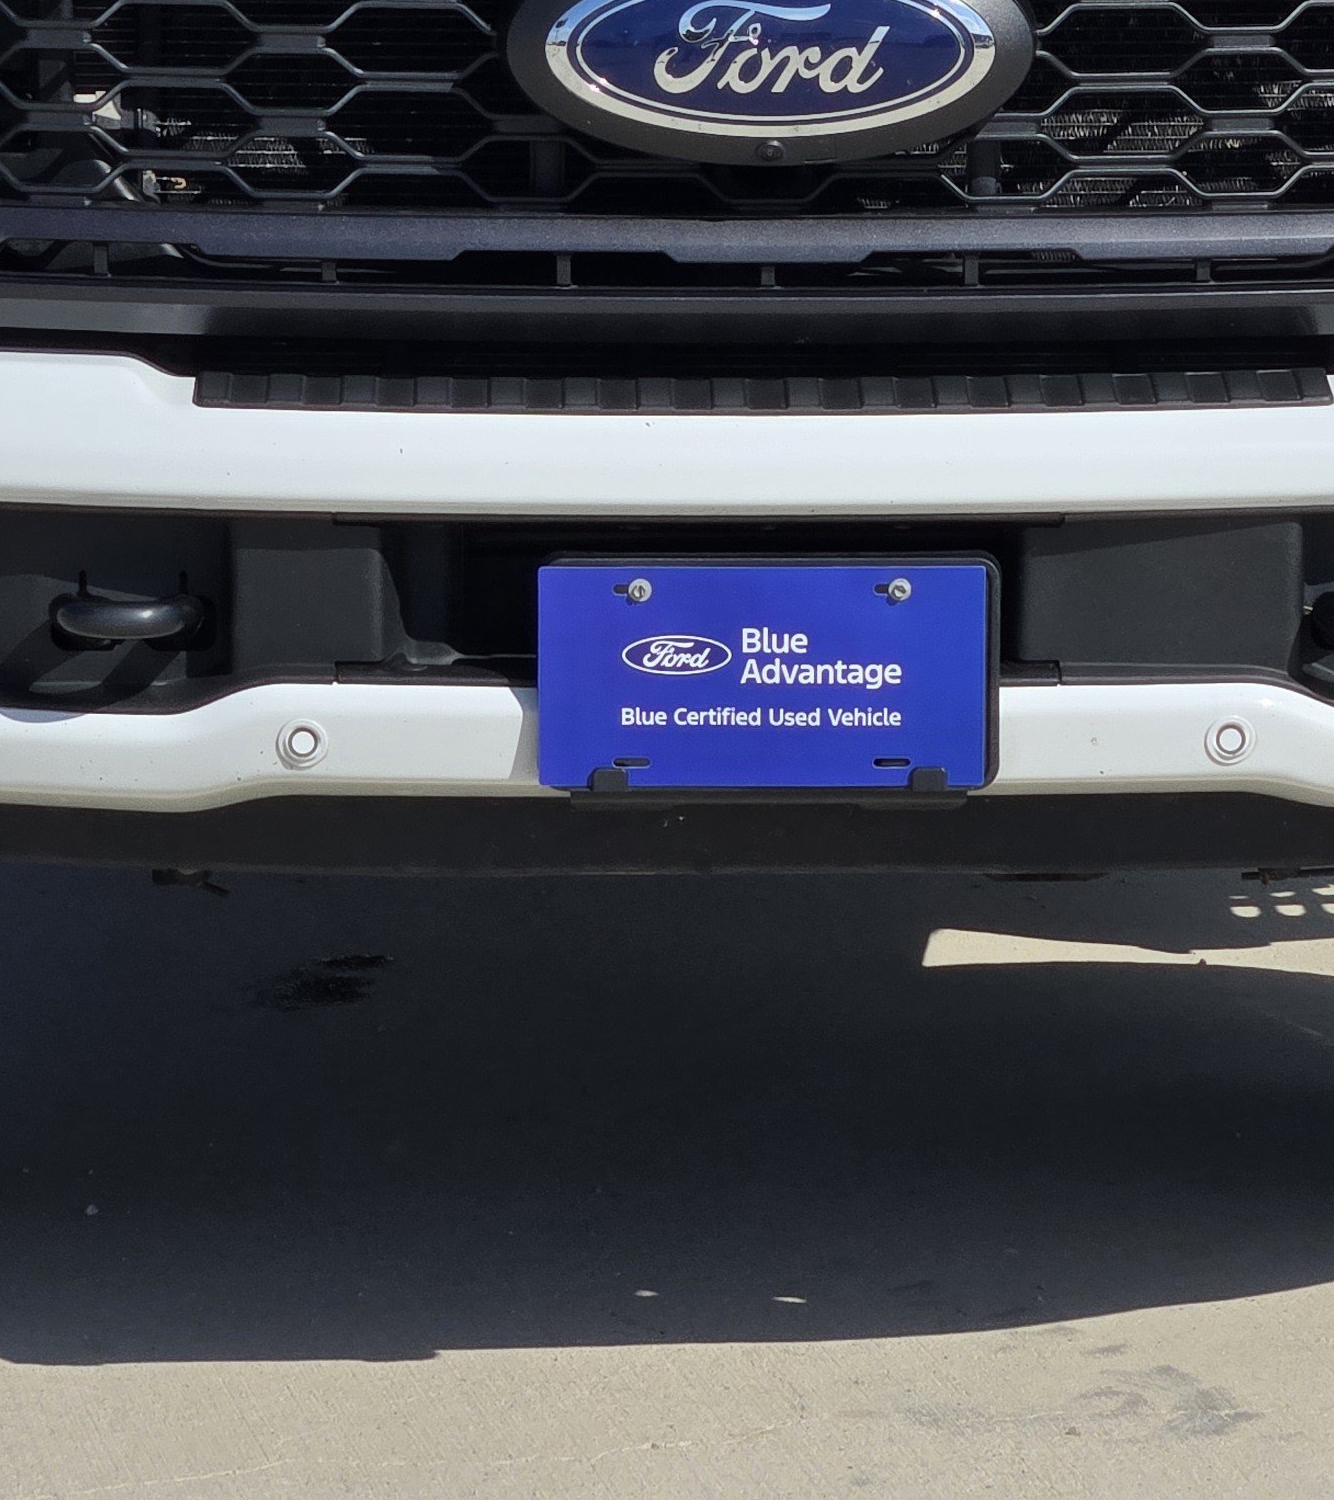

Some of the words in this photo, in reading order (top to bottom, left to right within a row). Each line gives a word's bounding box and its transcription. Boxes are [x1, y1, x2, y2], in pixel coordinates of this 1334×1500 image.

[654, 0, 890, 94] Ford
[642, 640, 712, 669] Ford
[743, 627, 808, 653] Blue
[740, 658, 902, 689] Advantage
[622, 707, 667, 725] Blue
[674, 707, 761, 726] Certified
[769, 708, 820, 726] Used
[828, 707, 901, 726] Vehicle
